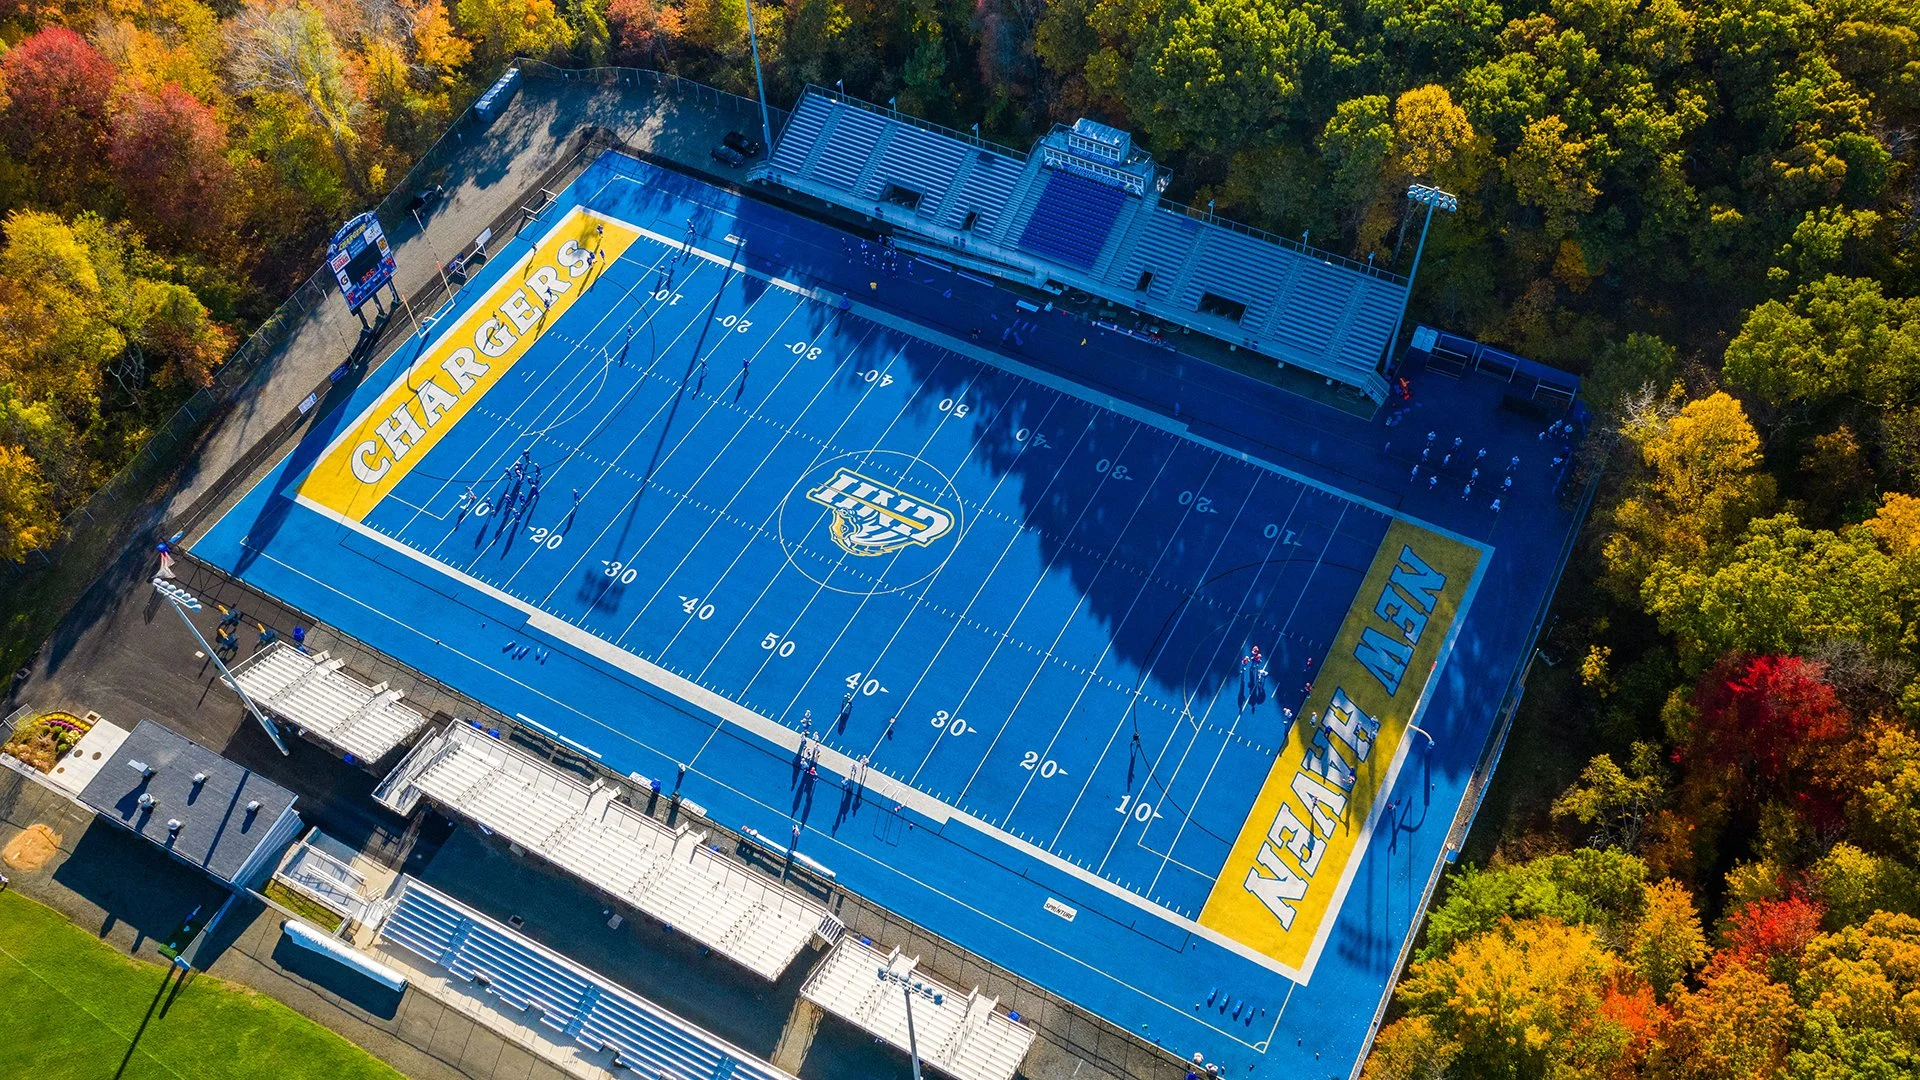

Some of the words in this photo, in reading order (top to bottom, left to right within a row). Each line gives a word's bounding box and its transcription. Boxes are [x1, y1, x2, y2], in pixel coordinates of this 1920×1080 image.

[655, 289, 684, 307] 10
[724, 315, 753, 334] 20
[350, 239, 594, 485] CHARGERS
[793, 341, 822, 361] 30
[864, 369, 894, 388] 40
[939, 398, 970, 418] 50
[1015, 428, 1045, 448] 40
[1096, 459, 1128, 480] 30
[1179, 490, 1212, 513] 20
[530, 527, 563, 550] 20
[1263, 523, 1297, 546] 10
[604, 561, 638, 585] 30
[682, 597, 716, 621] 40
[1353, 545, 1448, 696] NEW
[761, 632, 796, 658] 50
[845, 671, 880, 697] 40
[931, 710, 967, 737] 30
[1019, 751, 1058, 779] 20
[1115, 794, 1152, 822] 10
[1243, 686, 1381, 932] HAVEN
